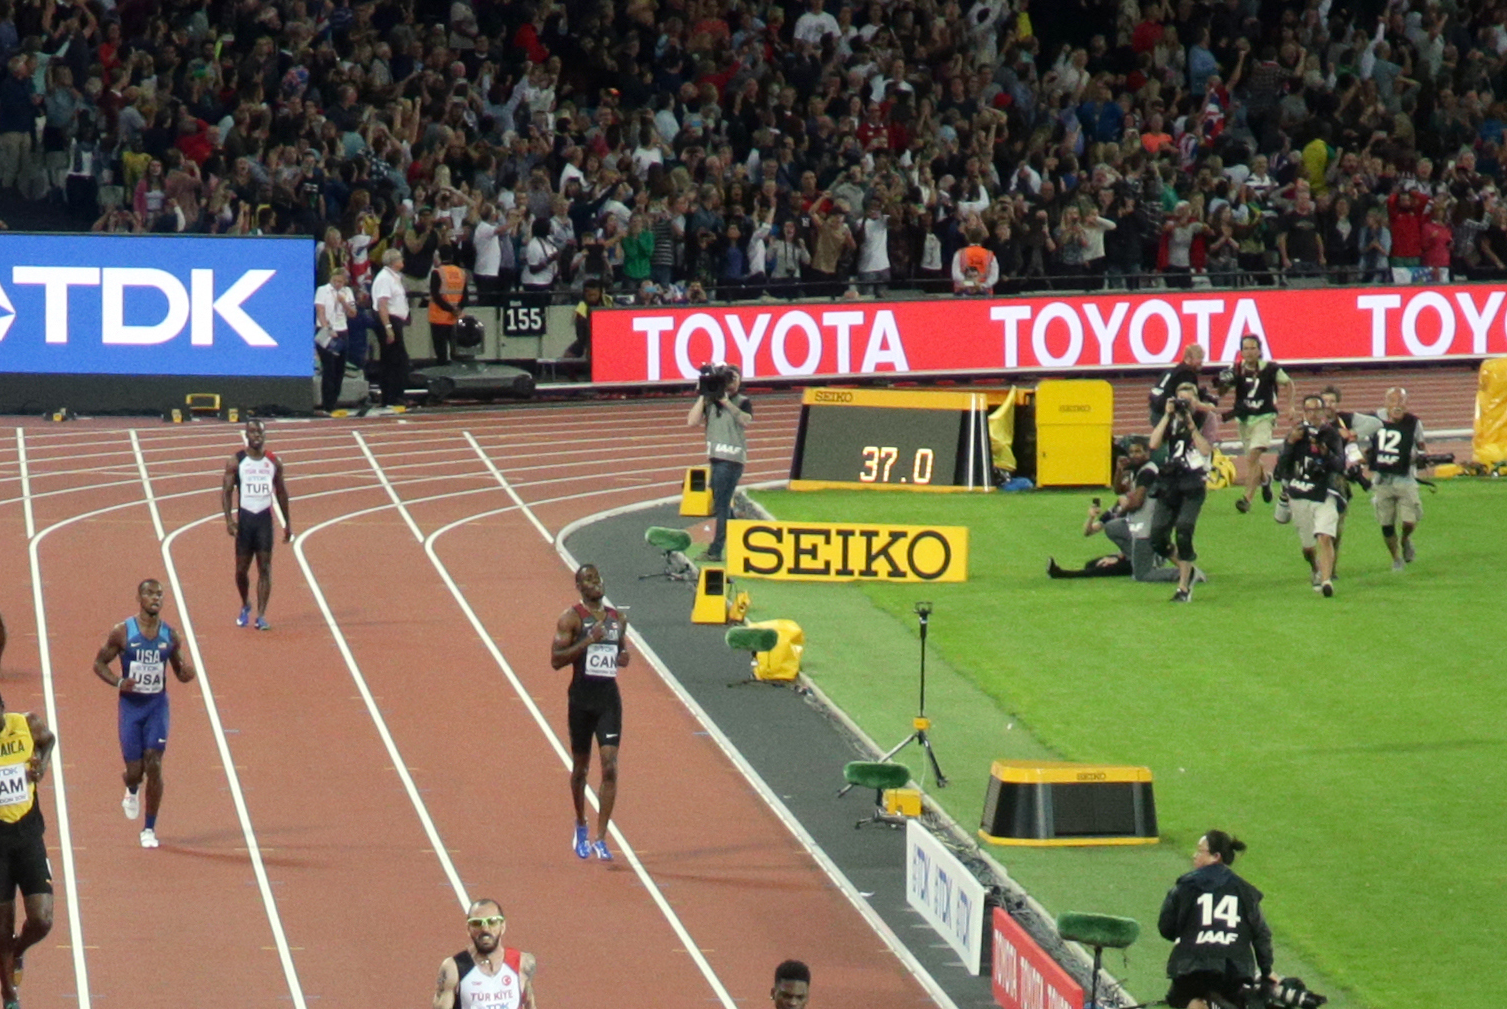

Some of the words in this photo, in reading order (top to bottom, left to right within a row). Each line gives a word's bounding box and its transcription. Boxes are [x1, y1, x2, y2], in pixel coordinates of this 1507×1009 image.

[13, 266, 279, 347] TDK
[507, 308, 542, 330] 155
[990, 299, 1273, 368] TOYOTA
[1357, 291, 1507, 358] TOY
[633, 310, 910, 381] TOYOTA
[815, 390, 853, 402] SEIKO
[1377, 428, 1402, 453] 12
[860, 446, 934, 484] 37.0
[246, 484, 269, 493] TUR
[742, 525, 952, 580] SEIKO
[135, 649, 161, 664] USA
[1197, 893, 1241, 928] 14
[1195, 930, 1239, 945] IAAF
